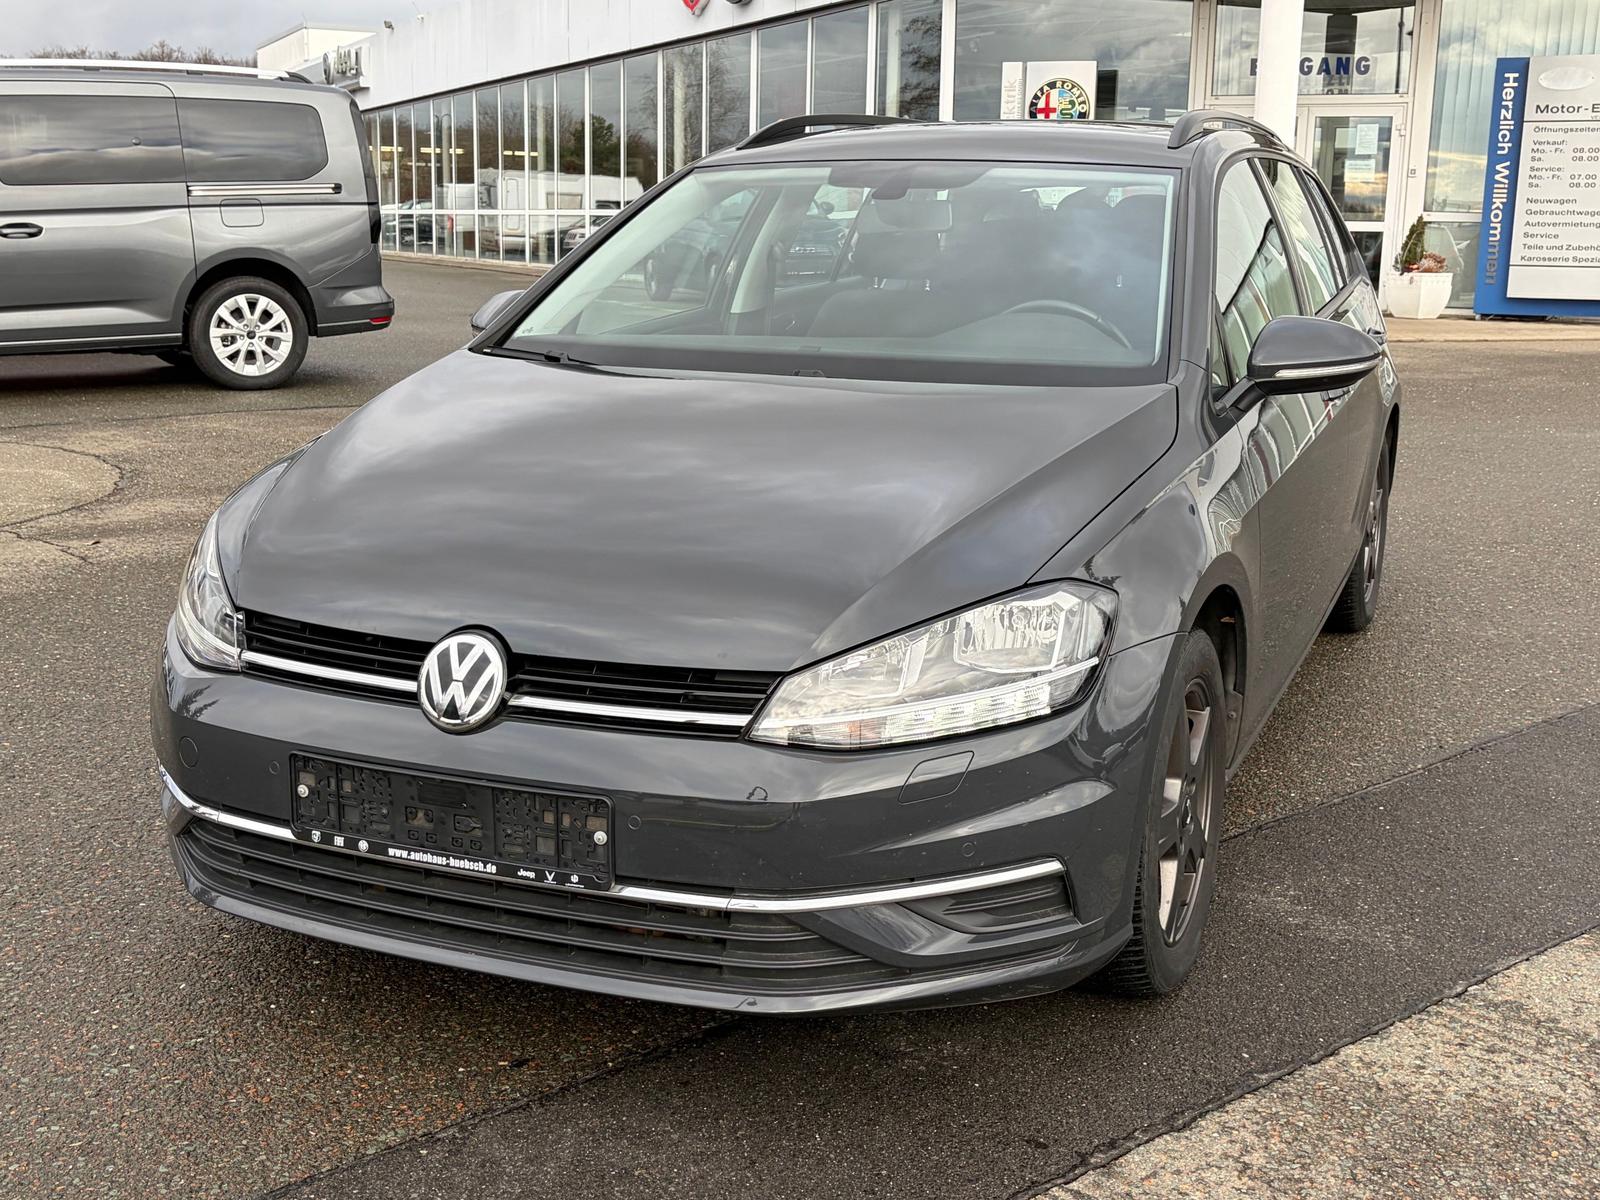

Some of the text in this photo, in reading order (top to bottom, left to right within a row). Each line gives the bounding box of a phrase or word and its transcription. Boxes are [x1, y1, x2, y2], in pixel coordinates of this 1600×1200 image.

[1249, 56, 1371, 76] GANG
[1030, 85, 1050, 113] ALFA
[1056, 81, 1087, 112] ROMEO
[1485, 73, 1519, 284] Herzlich Willkommen
[1526, 197, 1577, 205] Neuwagen
[1523, 231, 1560, 239] Service
[388, 848, 497, 874] www.autohaus-huebsch.de
[517, 868, 536, 879] Jeep
